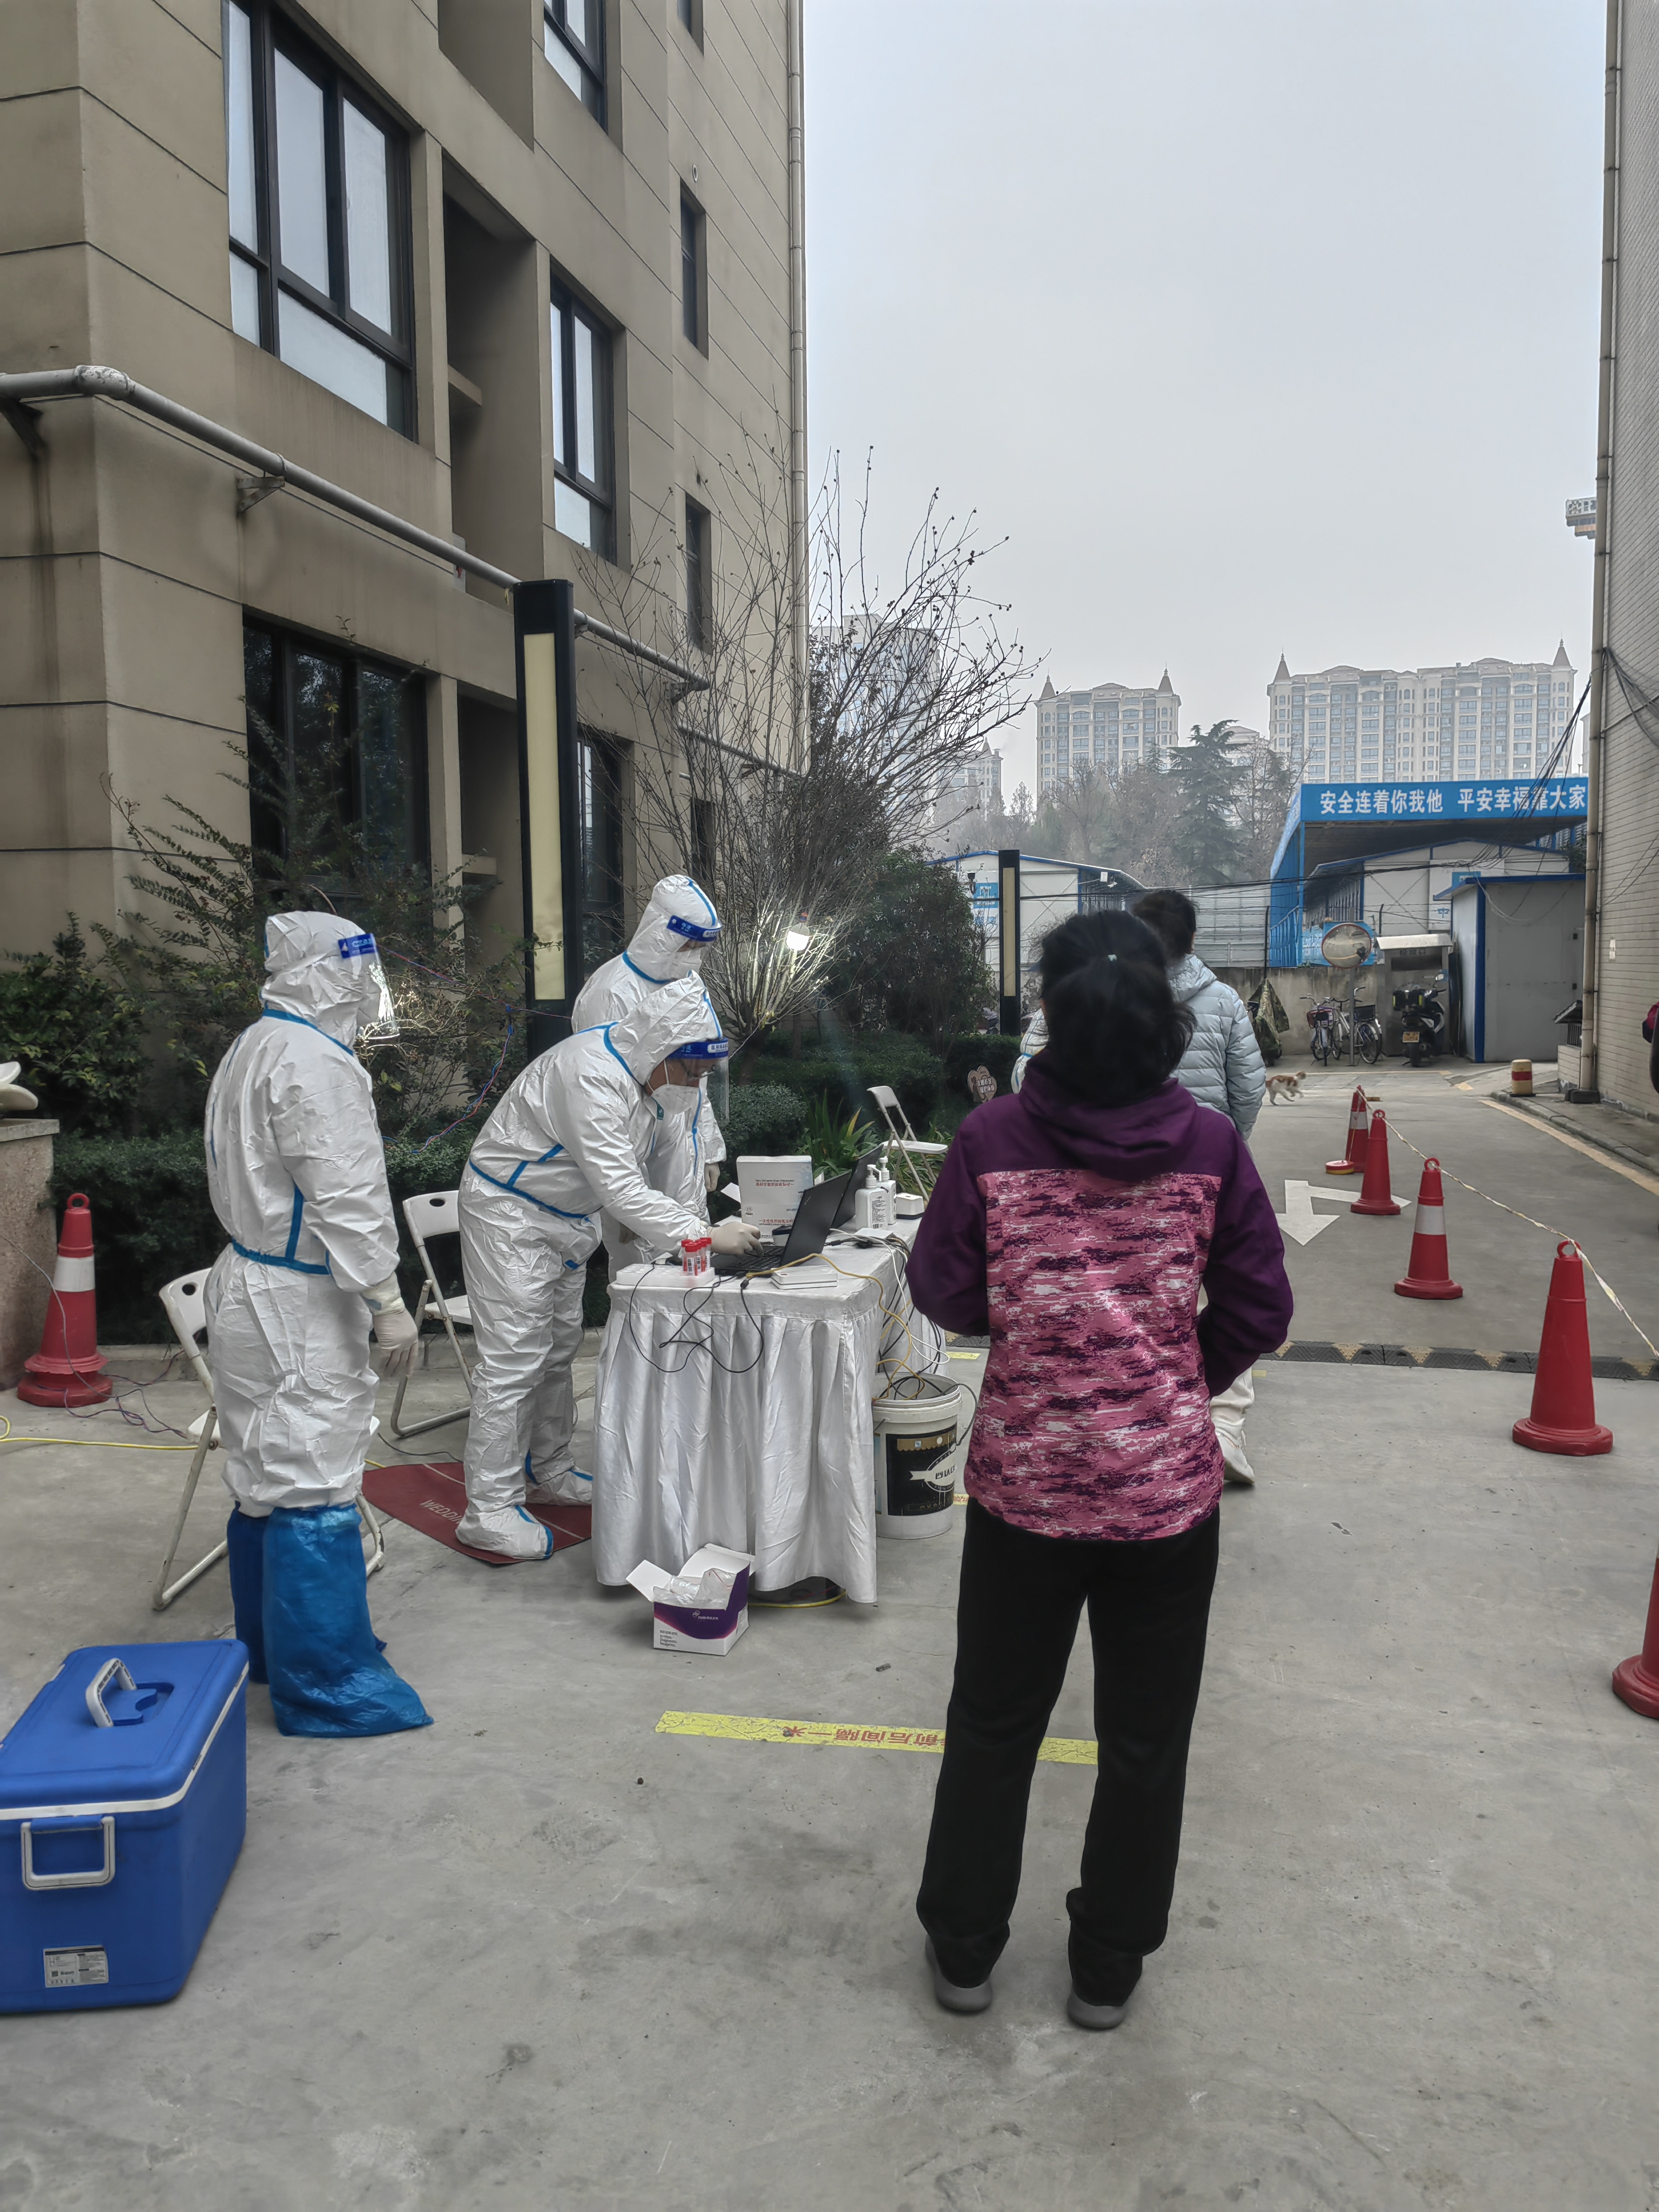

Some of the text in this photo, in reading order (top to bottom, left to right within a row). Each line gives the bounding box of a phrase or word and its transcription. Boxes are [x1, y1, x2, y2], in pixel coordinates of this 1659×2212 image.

[1320, 785, 1586, 814] 安全连着你我他 平安幸福靠大家
